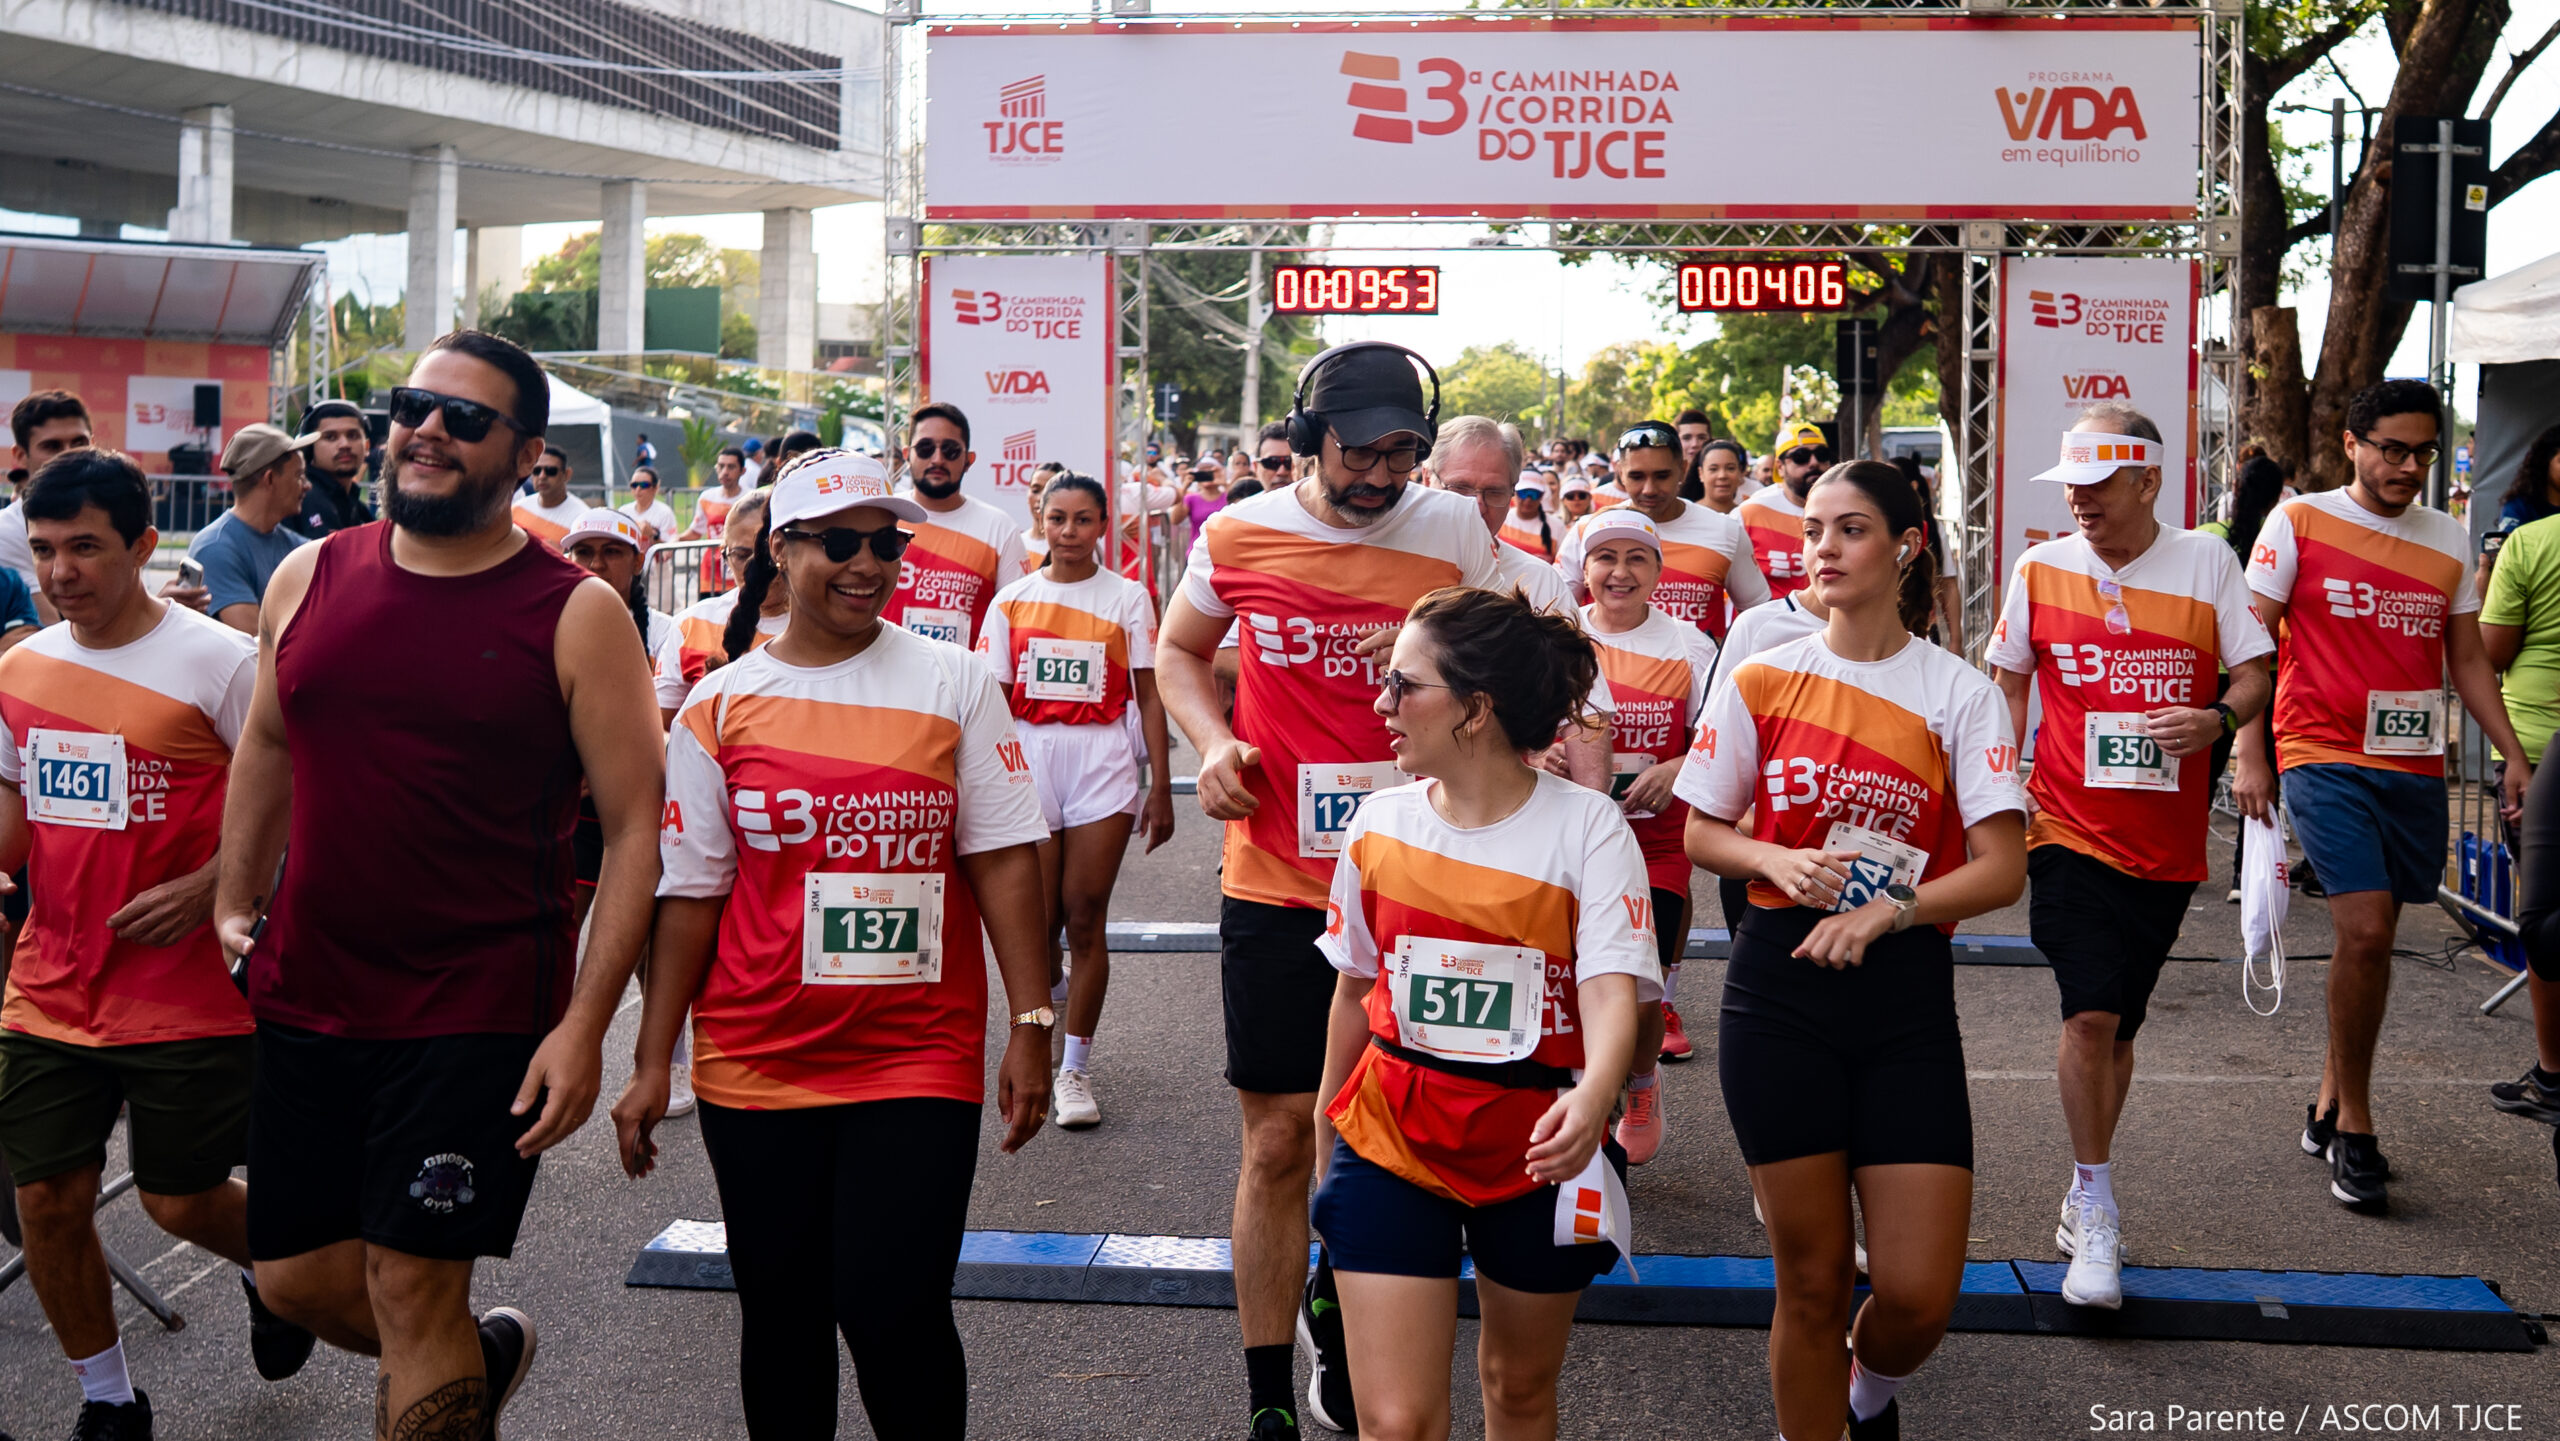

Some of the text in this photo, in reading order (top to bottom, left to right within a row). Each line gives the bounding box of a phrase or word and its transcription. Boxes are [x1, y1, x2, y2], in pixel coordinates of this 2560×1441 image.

[1491, 70, 1680, 92] CAMINHADA
[2028, 71, 2115, 83] PROGRAMA
[1478, 94, 1674, 125] /CORRIDA
[1994, 86, 2148, 141] VIDA
[983, 121, 1064, 154] TJCE
[1478, 128, 1666, 179] DO TJCE
[2001, 142, 2141, 168] em equilíbrio
[1010, 296, 1086, 305] CAMINHADA
[1276, 269, 1437, 311] 00:09:53
[1005, 306, 1084, 318] /CORRIDA
[2086, 309, 2167, 322] /CORRIDA
[2091, 299, 2170, 309] CAMINHADA
[1006, 319, 1081, 339] DO TJCE
[2085, 322, 2164, 343] DO TJCE
[985, 370, 1051, 394] VIDA
[2062, 375, 2131, 399] VIDA
[990, 463, 1040, 486] TJC
[922, 568, 982, 586] CAMINHADA
[1656, 581, 1714, 592] AMINHADA
[915, 587, 975, 612] DO TJCE
[1651, 590, 1712, 602] CORRIDA
[1668, 601, 1709, 621] TJCE
[2378, 613, 2441, 638] DO TJCE
[1323, 656, 1358, 678] DO
[2113, 649, 2197, 661] CAMINHADA
[1042, 658, 1082, 683] 916
[2109, 661, 2195, 677] /CORRIDA
[2109, 677, 2193, 703] DO TJCE
[1615, 700, 1675, 712] MINHADA
[1610, 711, 1673, 726] ORRIDA
[2384, 711, 2425, 735] 652
[1621, 725, 1671, 749] TJCE
[2107, 737, 2155, 766] 350
[40, 761, 106, 799] 1461
[1304, 778, 1312, 797] 5KM
[1829, 763, 1929, 802] CAMINHADA
[128, 792, 167, 823] CE
[832, 790, 954, 811] CAMINHADA
[1317, 794, 1372, 829] 12
[824, 808, 951, 834] /CORRIDA
[826, 831, 944, 869] DO TJCE
[811, 890, 820, 913] 3KM
[839, 910, 908, 950] 137
[1399, 954, 1410, 979] 3KM
[1422, 978, 1499, 1025] 517
[423, 1152, 474, 1171] GHOST
[423, 1196, 454, 1210] GYM
